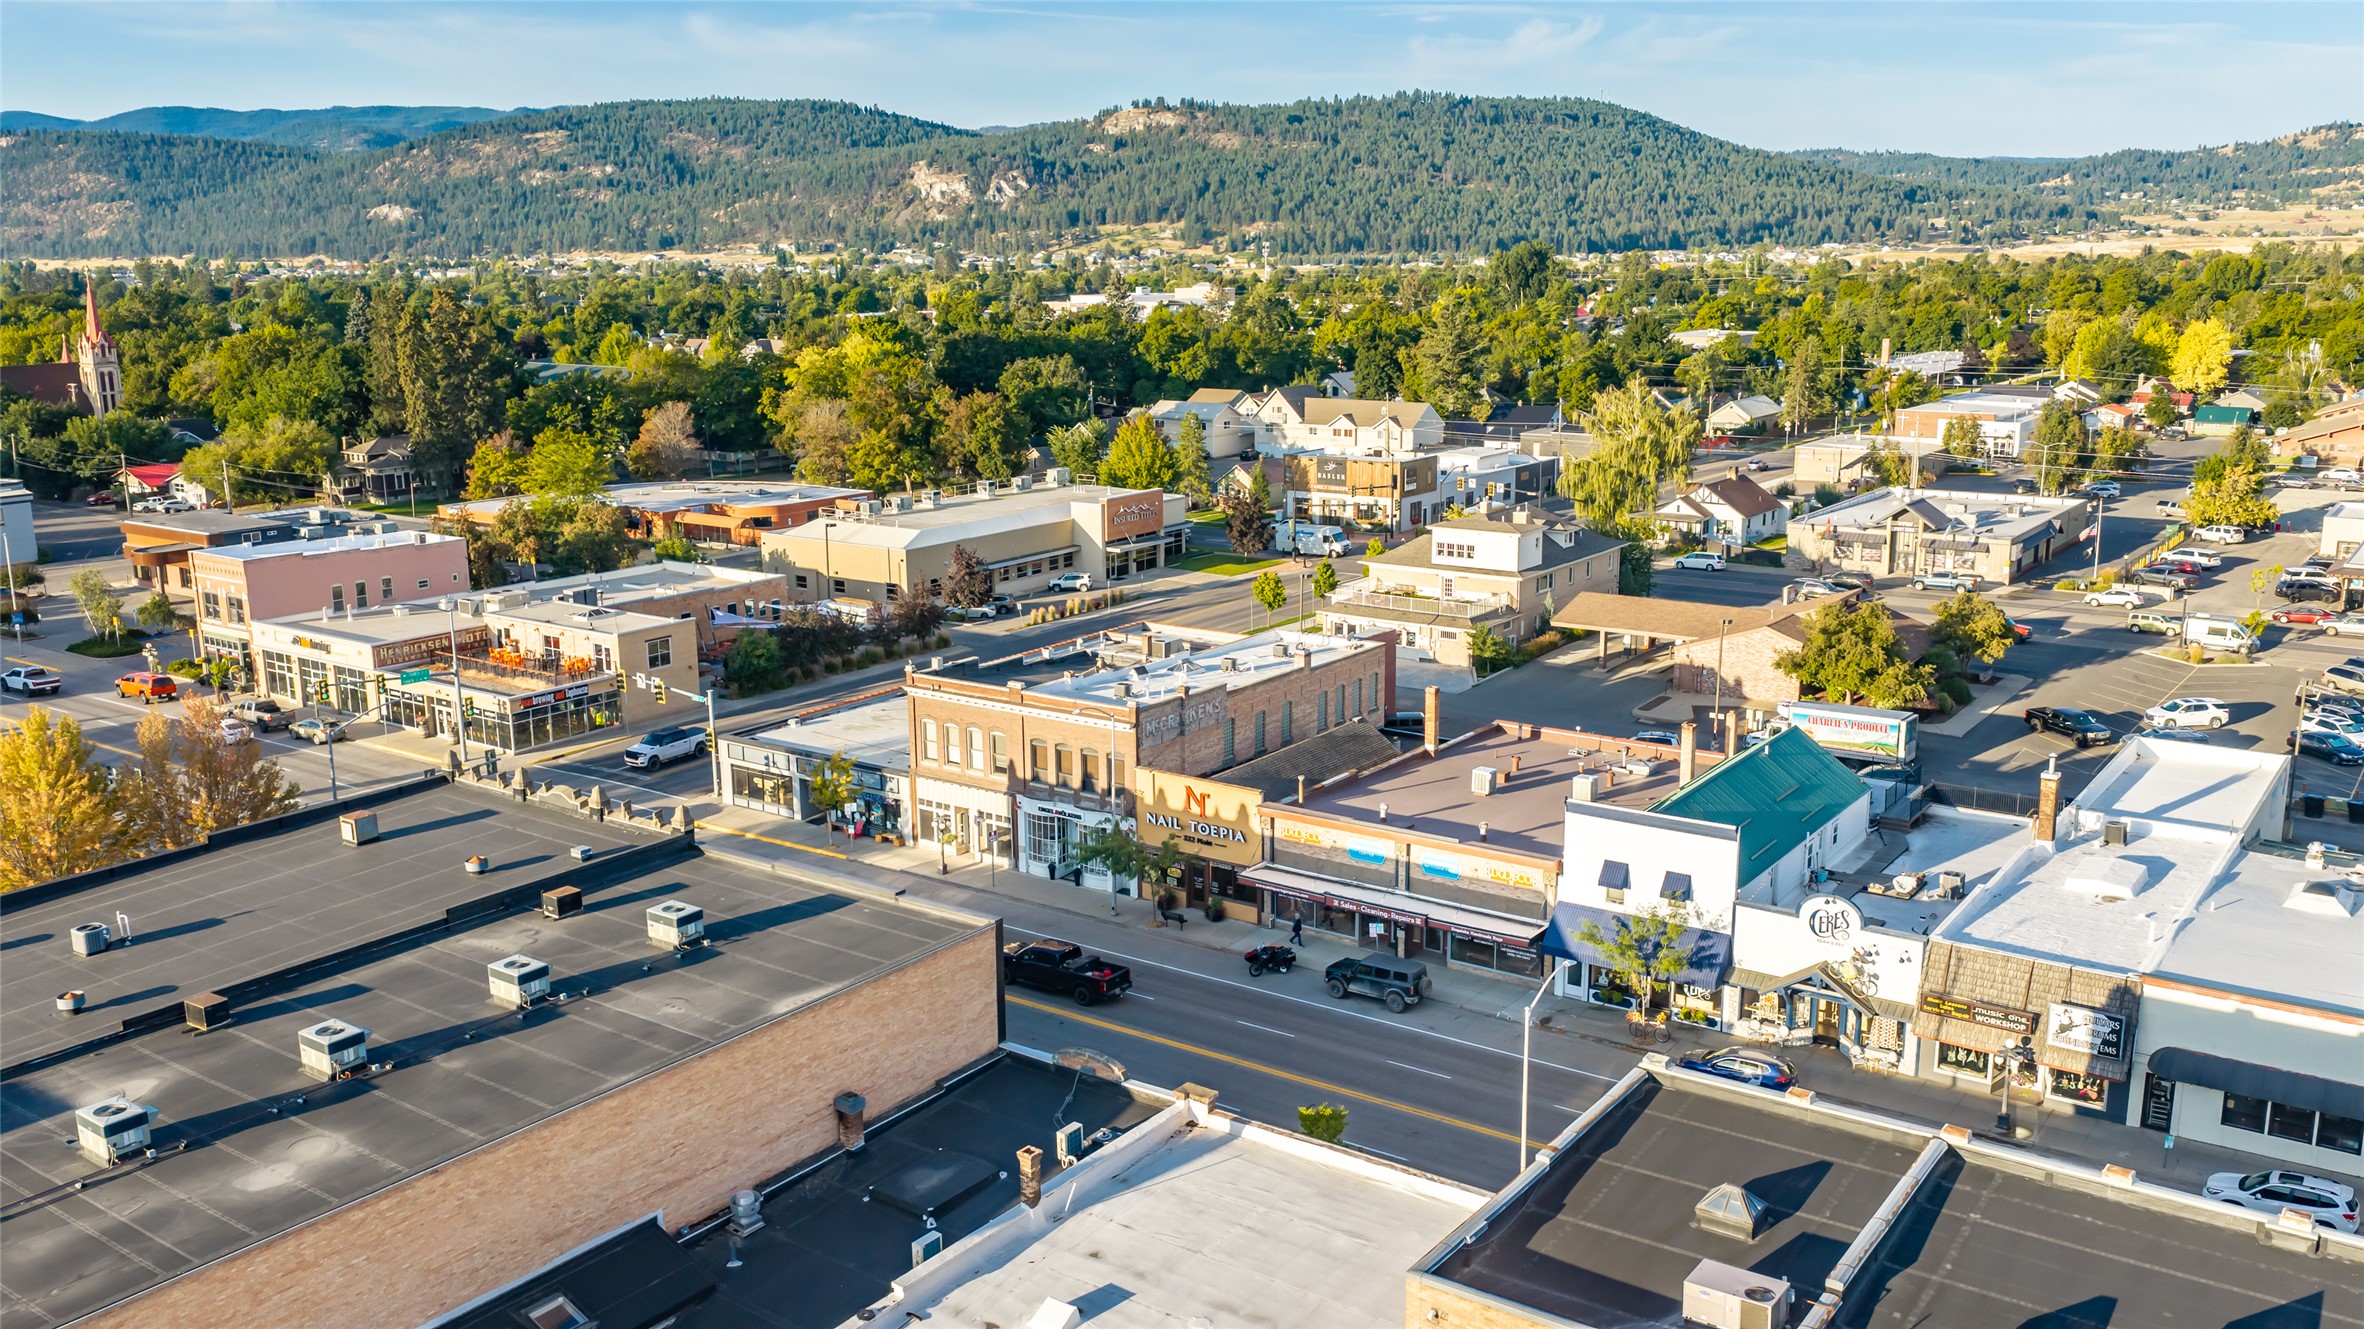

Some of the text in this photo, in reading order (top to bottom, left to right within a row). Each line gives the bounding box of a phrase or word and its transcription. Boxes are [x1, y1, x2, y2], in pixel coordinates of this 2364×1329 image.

[1317, 472, 1345, 480] BASLER
[1113, 514, 1140, 525] INSURED
[380, 638, 449, 660] HENRICKSEN
[1851, 720, 1890, 734] PRODUCE
[1146, 812, 1247, 843] NAIL TOEPIA
[1340, 900, 1415, 925] Sales Cleaning Repairs
[1809, 909, 1850, 941] CERES
[1923, 1005, 1970, 1019] Service Repair
[1945, 1000, 1968, 1010] Lessons
[1975, 1014, 2026, 1031] WORKSHOP
[2082, 1014, 2120, 1030] GUITARS
[2086, 1027, 2117, 1042] DRUMS
